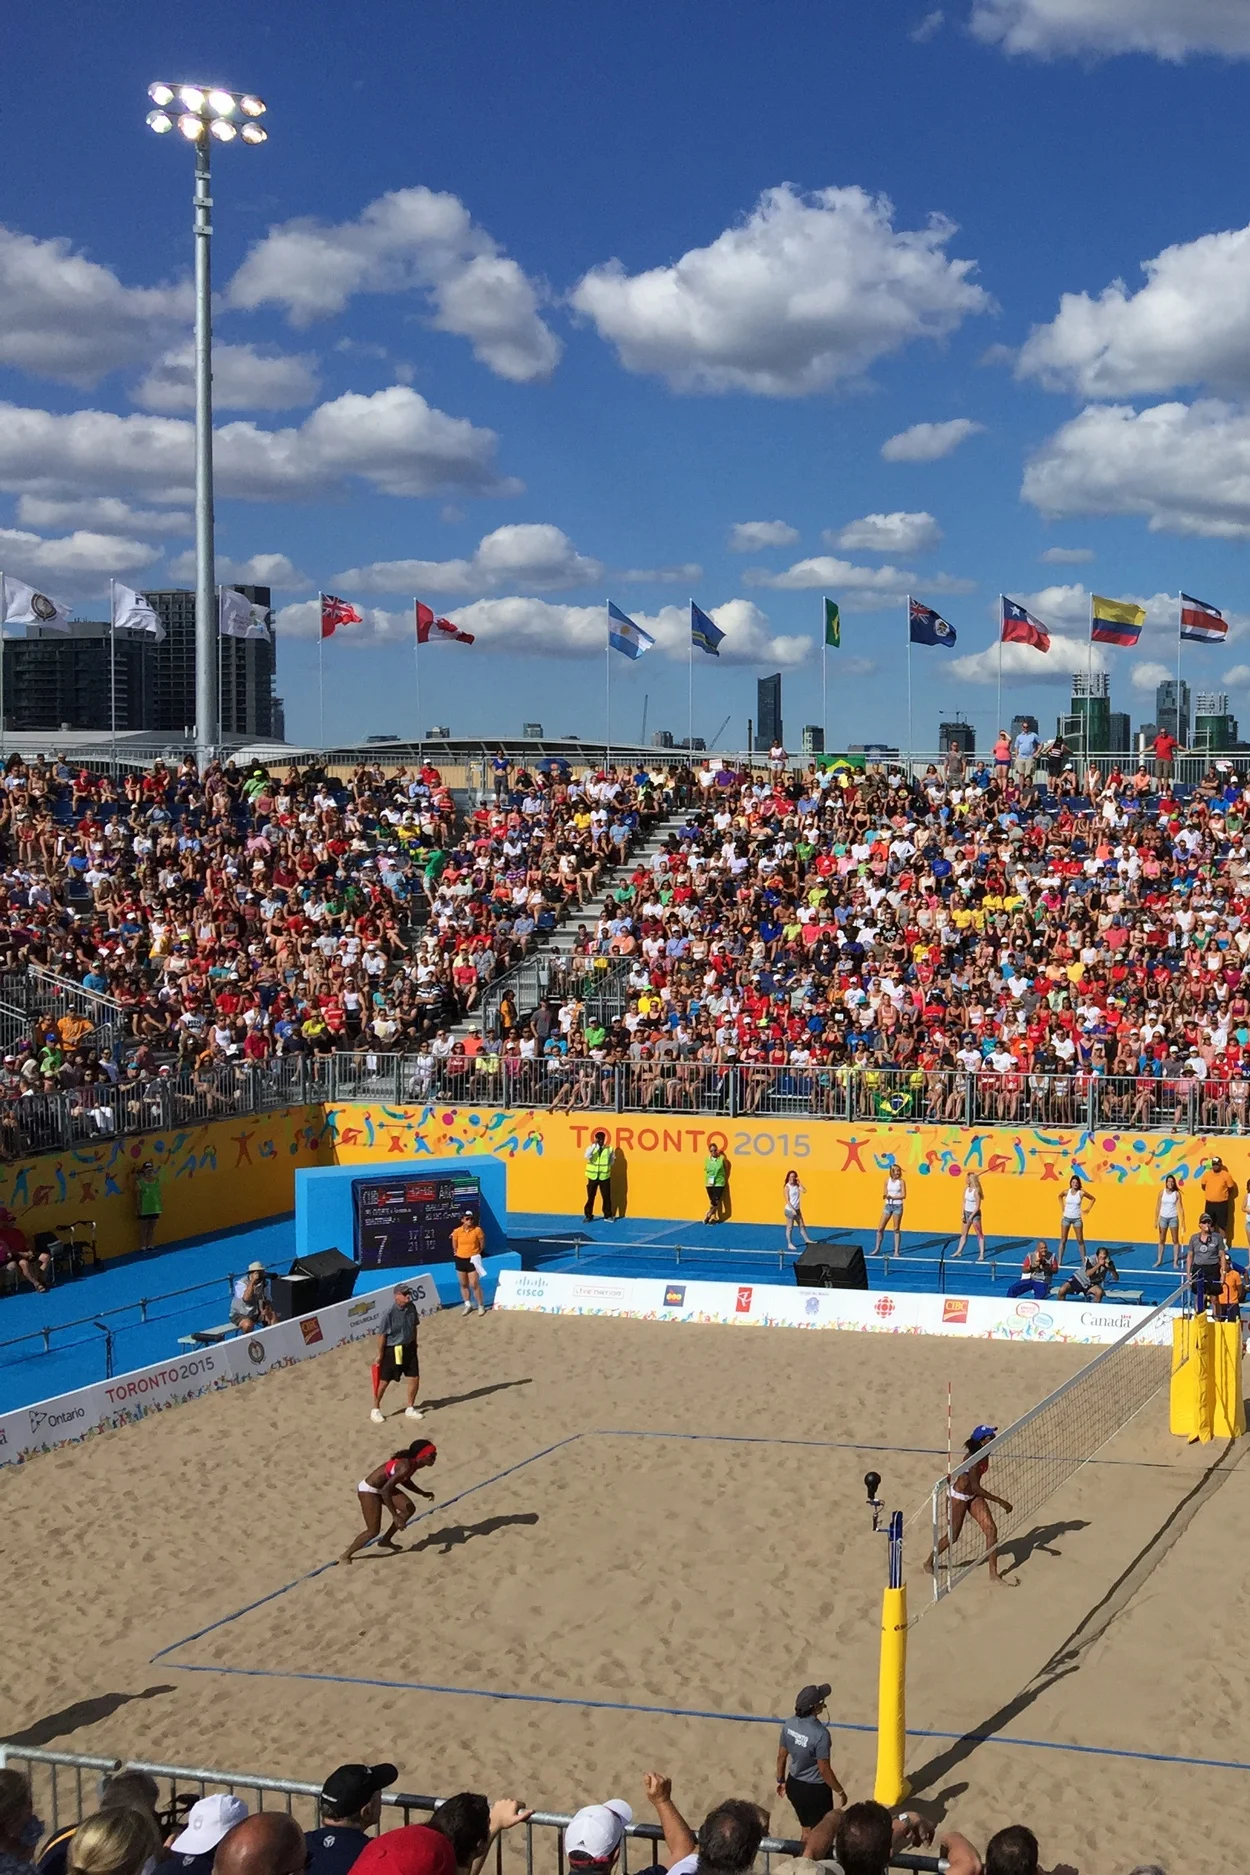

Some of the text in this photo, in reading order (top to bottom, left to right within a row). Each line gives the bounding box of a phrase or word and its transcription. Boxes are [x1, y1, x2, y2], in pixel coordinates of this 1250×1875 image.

[569, 1126, 811, 1158] TORONTO 2015
[374, 1235, 388, 1264] 7
[945, 1300, 969, 1311] CIBC
[1080, 1312, 1131, 1328] Canada
[105, 1356, 215, 1403] TORONTO 2015
[48, 1407, 86, 1428] Ontario
